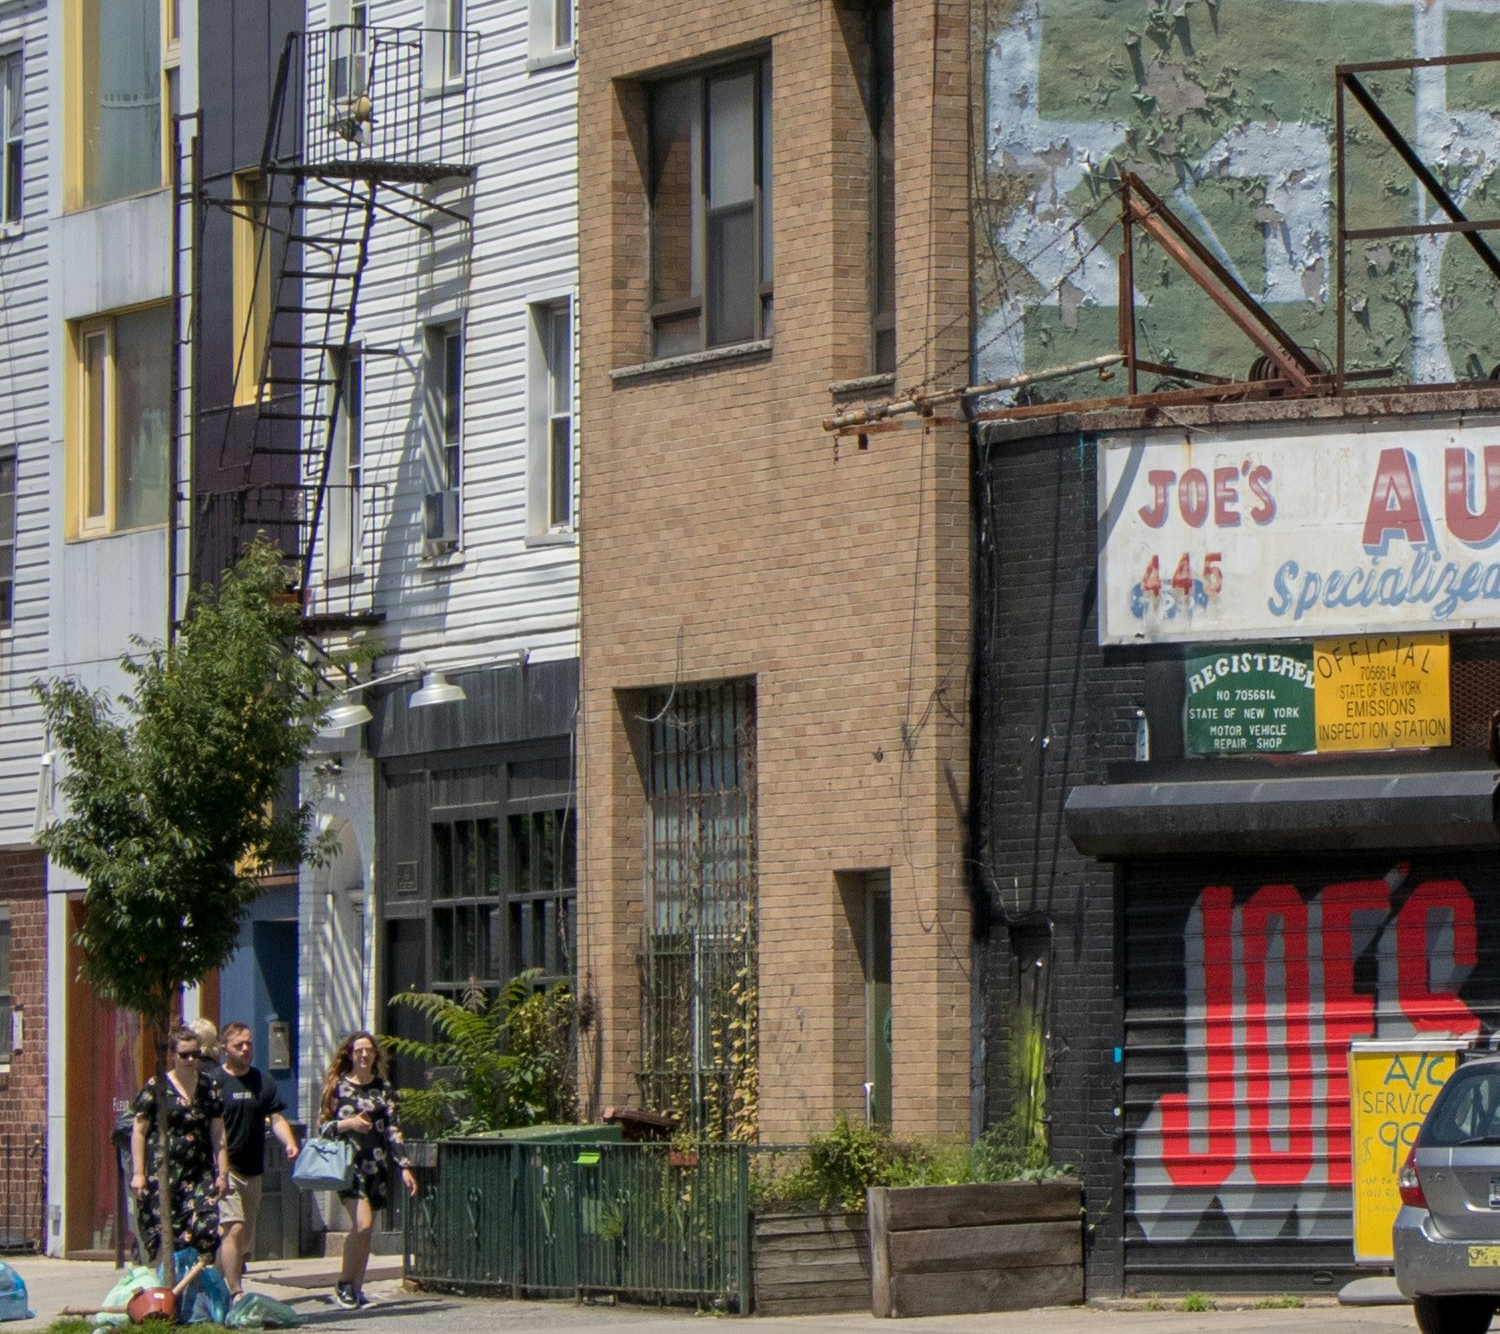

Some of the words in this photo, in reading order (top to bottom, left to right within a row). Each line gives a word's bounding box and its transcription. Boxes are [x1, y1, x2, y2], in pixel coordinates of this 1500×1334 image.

[1138, 461, 1278, 529] JOE'S
[1142, 551, 1224, 598] 445
[1188, 652, 1315, 695] REGISTERED
[1216, 690, 1230, 702] NO
[1340, 684, 1366, 700] STATE
[1366, 682, 1379, 698] OF
[1380, 681, 1398, 696] NEW
[1400, 680, 1422, 696] YORK
[1189, 708, 1218, 720] STATE
[1224, 708, 1238, 719] OF
[1244, 708, 1265, 719] NEW
[1273, 707, 1300, 719] YORK
[1346, 698, 1417, 718] EMISSIONS
[1210, 725, 1242, 736] MOTOR
[1250, 724, 1288, 736] VEHICLE
[1393, 718, 1446, 739] STATION
[1214, 738, 1247, 749] REPAIR
[1257, 737, 1283, 749] SHOP
[1384, 1052, 1445, 1091] A/C
[1362, 1090, 1434, 1115] SERVIC
